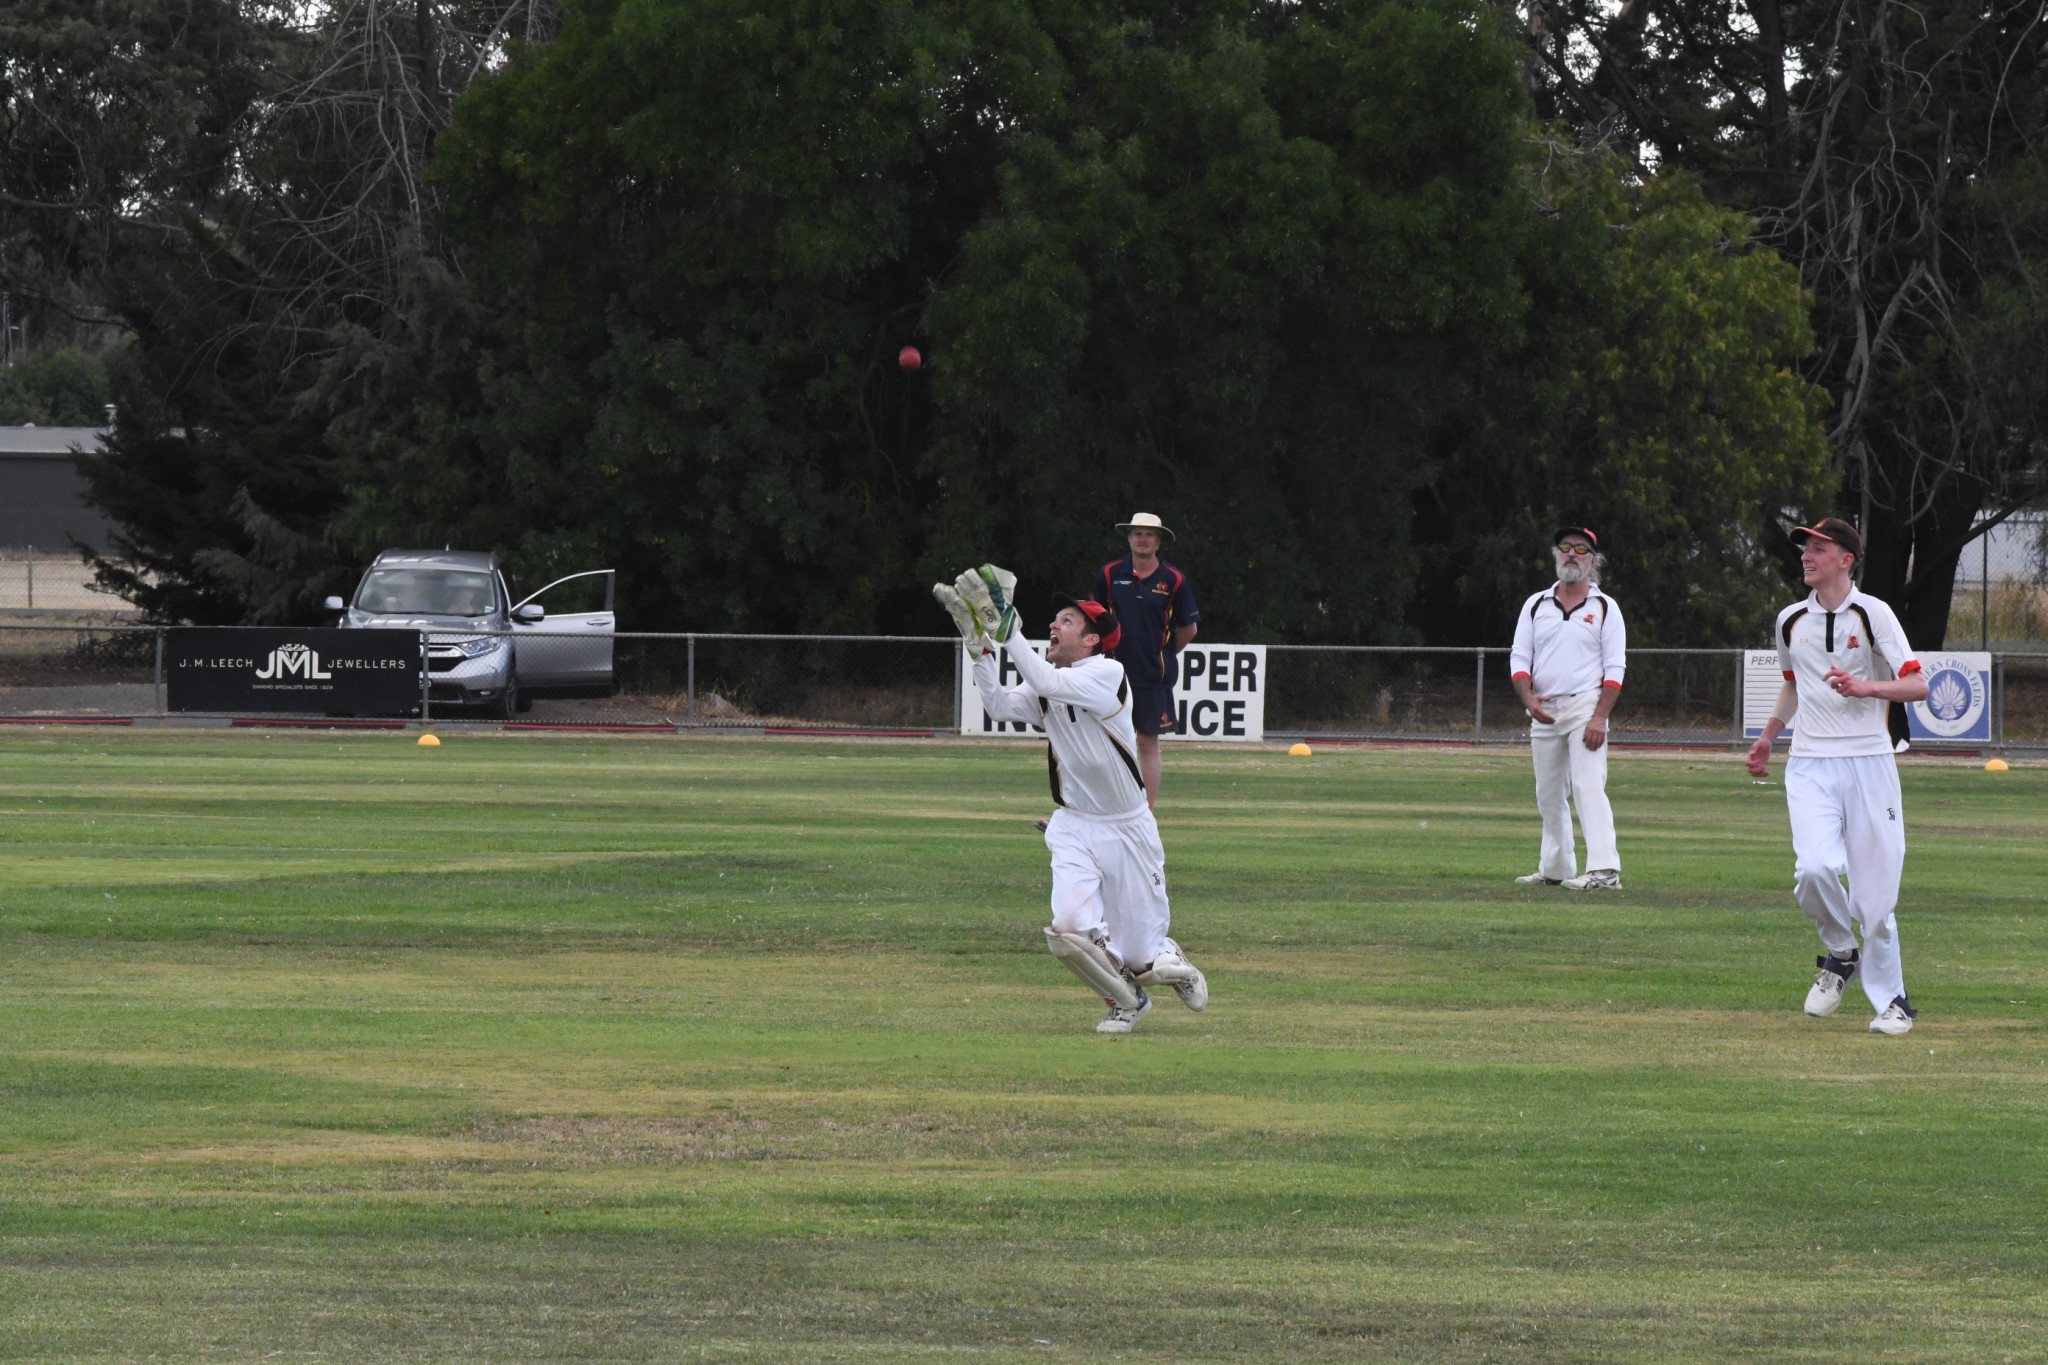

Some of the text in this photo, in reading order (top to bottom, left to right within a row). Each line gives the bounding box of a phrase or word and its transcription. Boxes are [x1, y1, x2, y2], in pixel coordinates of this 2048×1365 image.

[255, 649, 332, 679] JML
[327, 659, 406, 669] JEWELLERS
[1182, 650, 1258, 692] PER
[1751, 655, 1780, 666] PERF
[1946, 659, 1973, 677] CROSS
[1970, 676, 1982, 708] FEEDS
